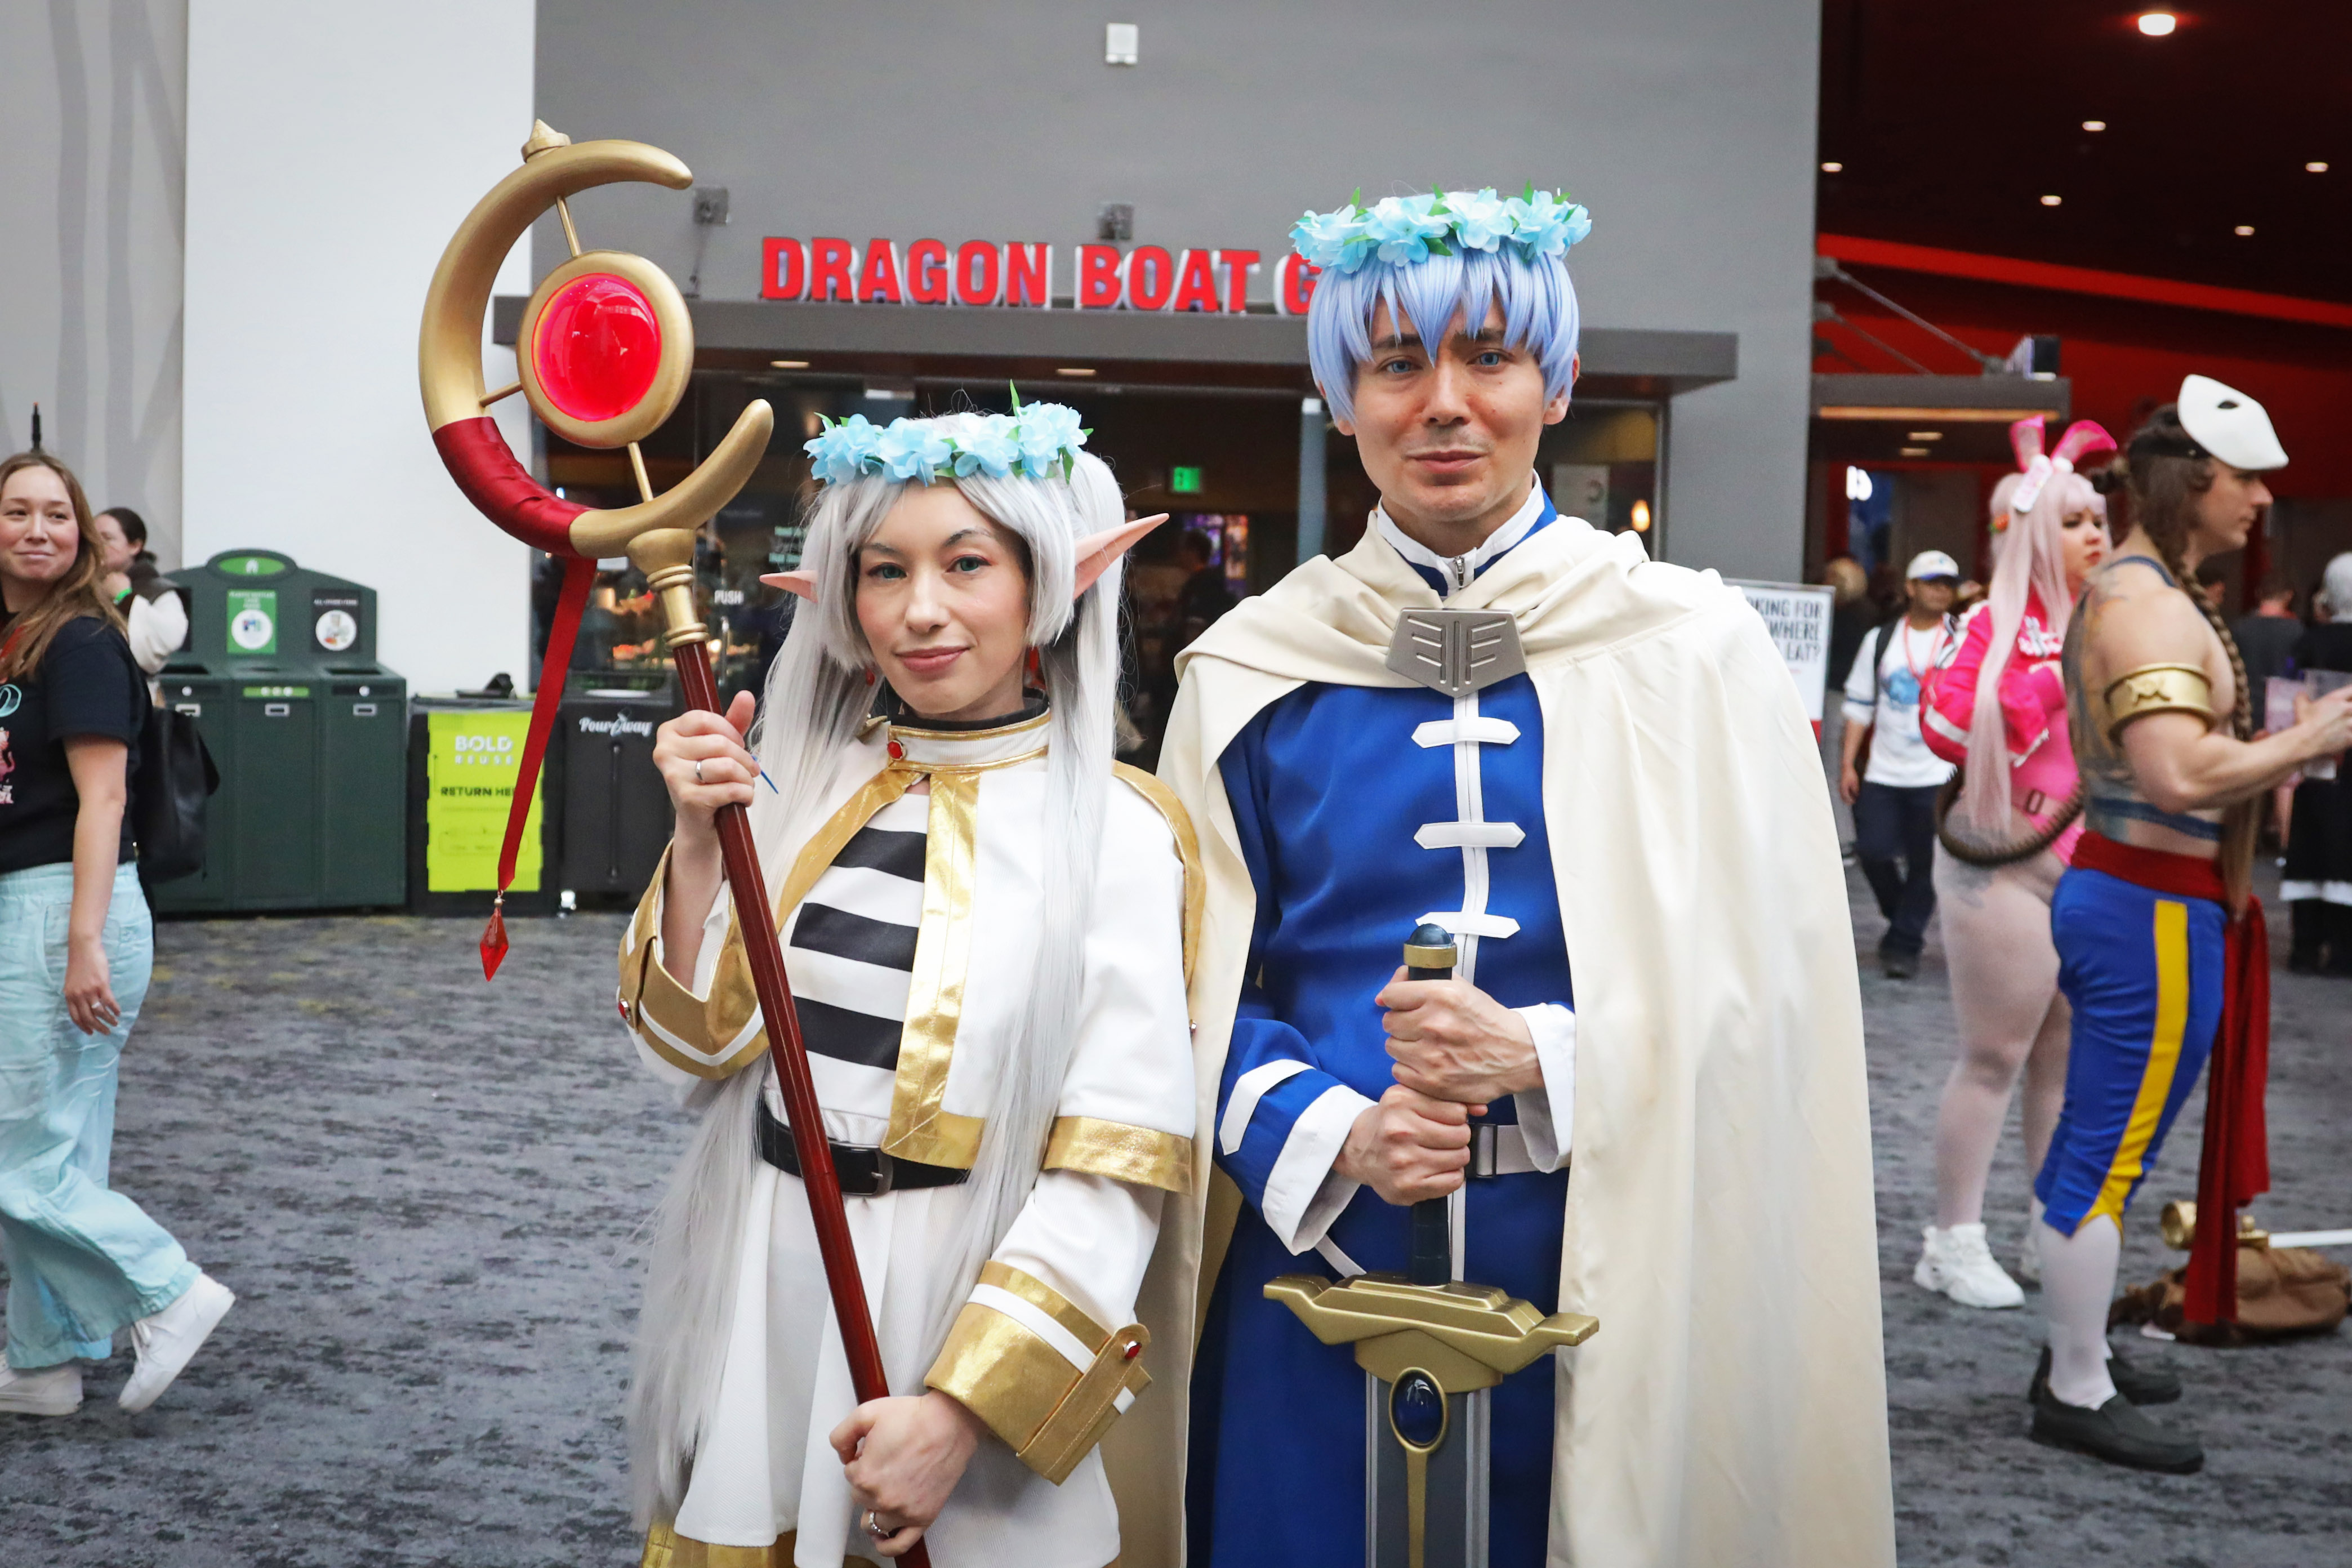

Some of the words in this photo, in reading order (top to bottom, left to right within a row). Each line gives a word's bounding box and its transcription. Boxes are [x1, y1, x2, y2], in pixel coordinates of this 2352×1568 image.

[761, 237, 1051, 309] DRAGON
[1075, 244, 1260, 313] BOAT
[714, 590, 743, 604] PUSH
[1796, 599, 1823, 619] FOR
[455, 735, 513, 752] BOLD
[441, 787, 492, 796] RETURN
